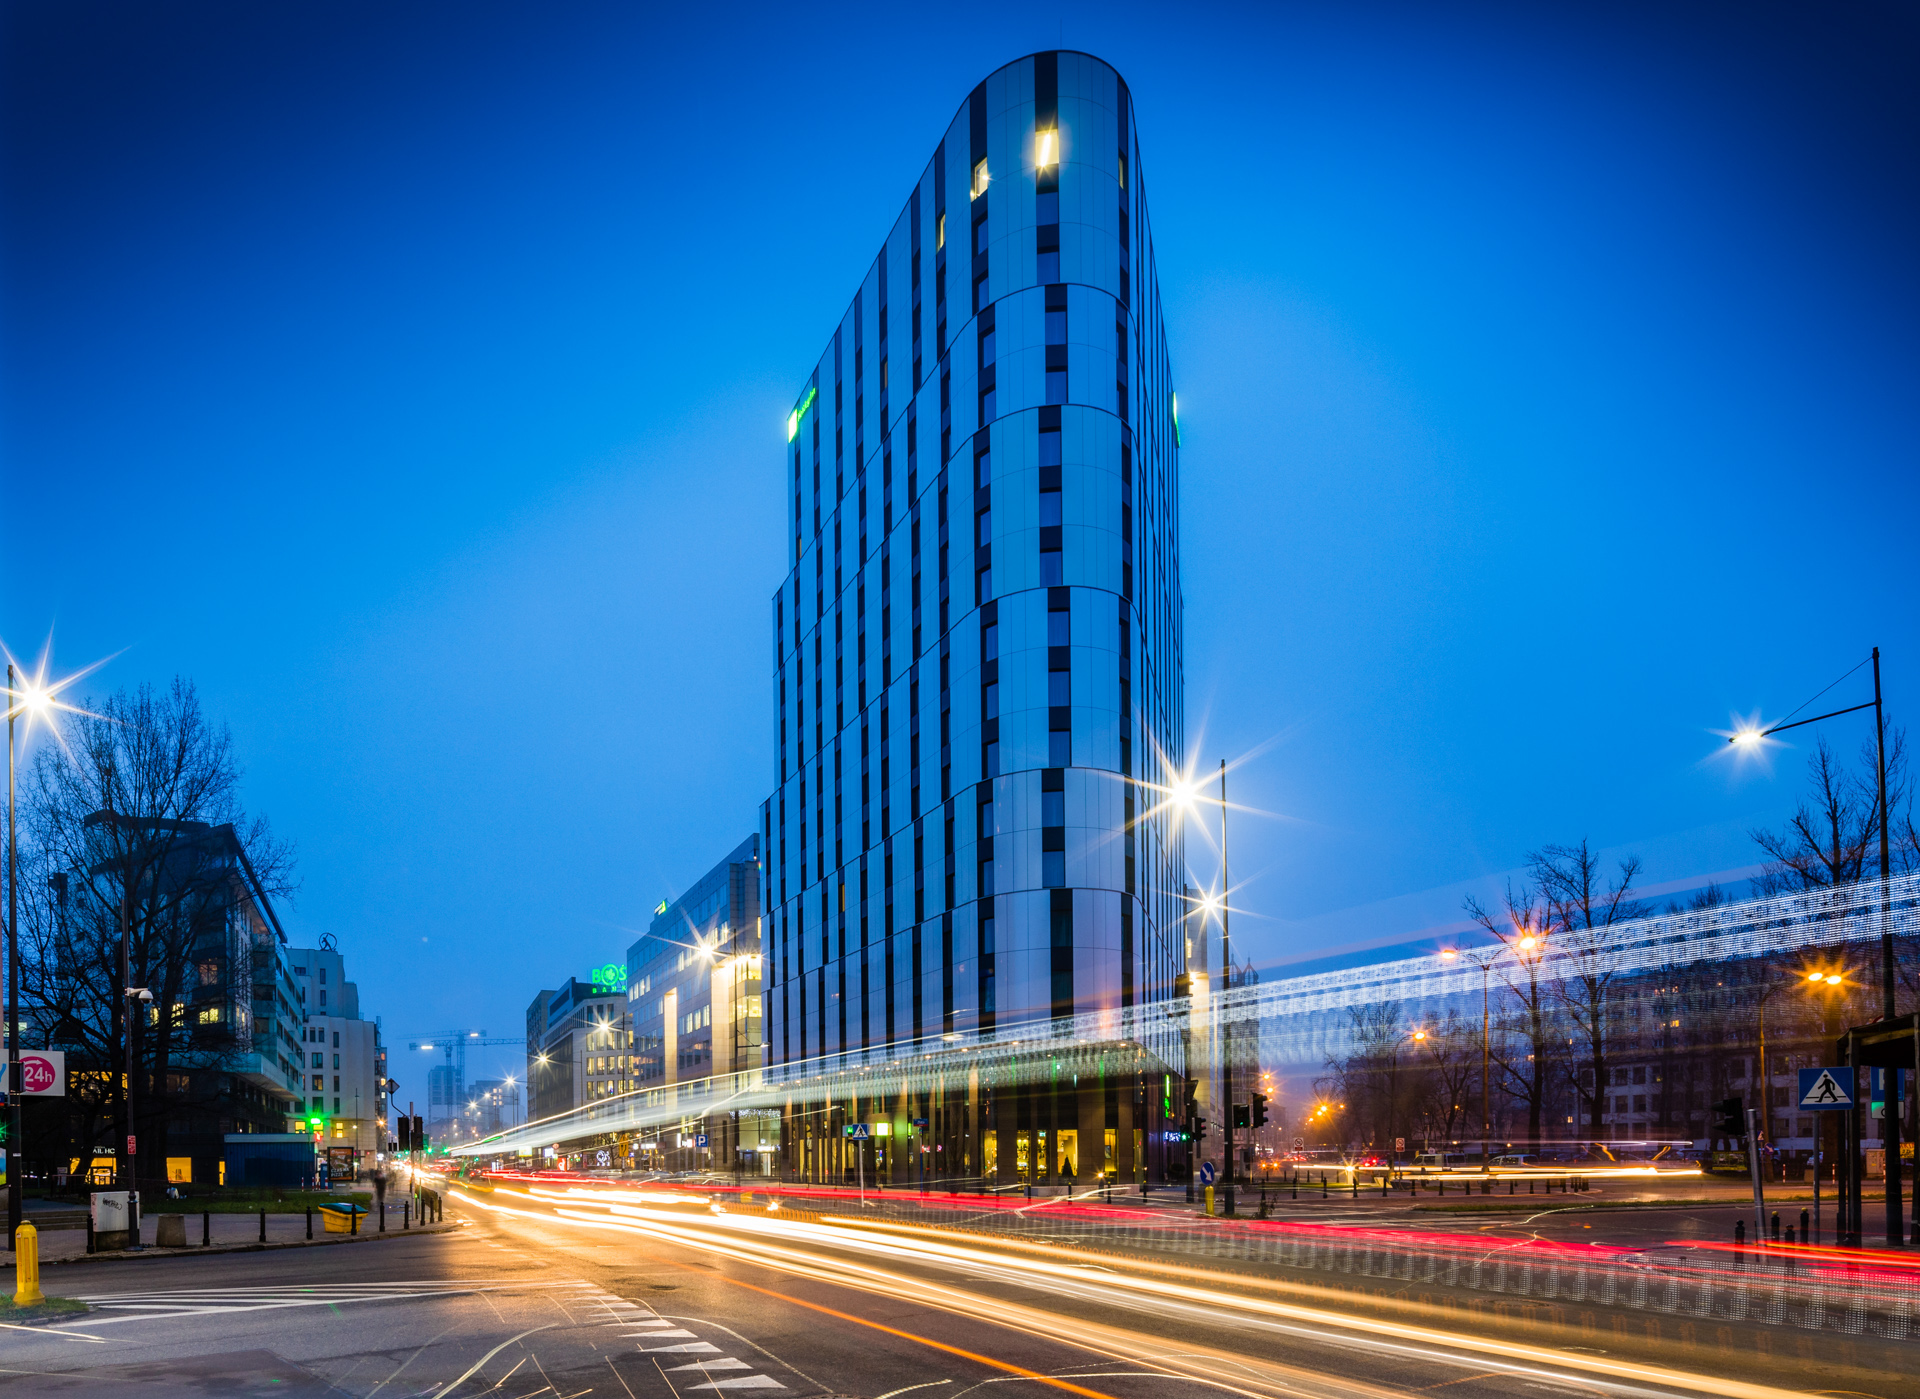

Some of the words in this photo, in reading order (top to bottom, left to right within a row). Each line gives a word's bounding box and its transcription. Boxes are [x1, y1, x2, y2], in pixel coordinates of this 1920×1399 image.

[592, 963, 627, 986] BOŚ
[25, 1066, 53, 1083] 24h
[698, 1136, 706, 1146] P
